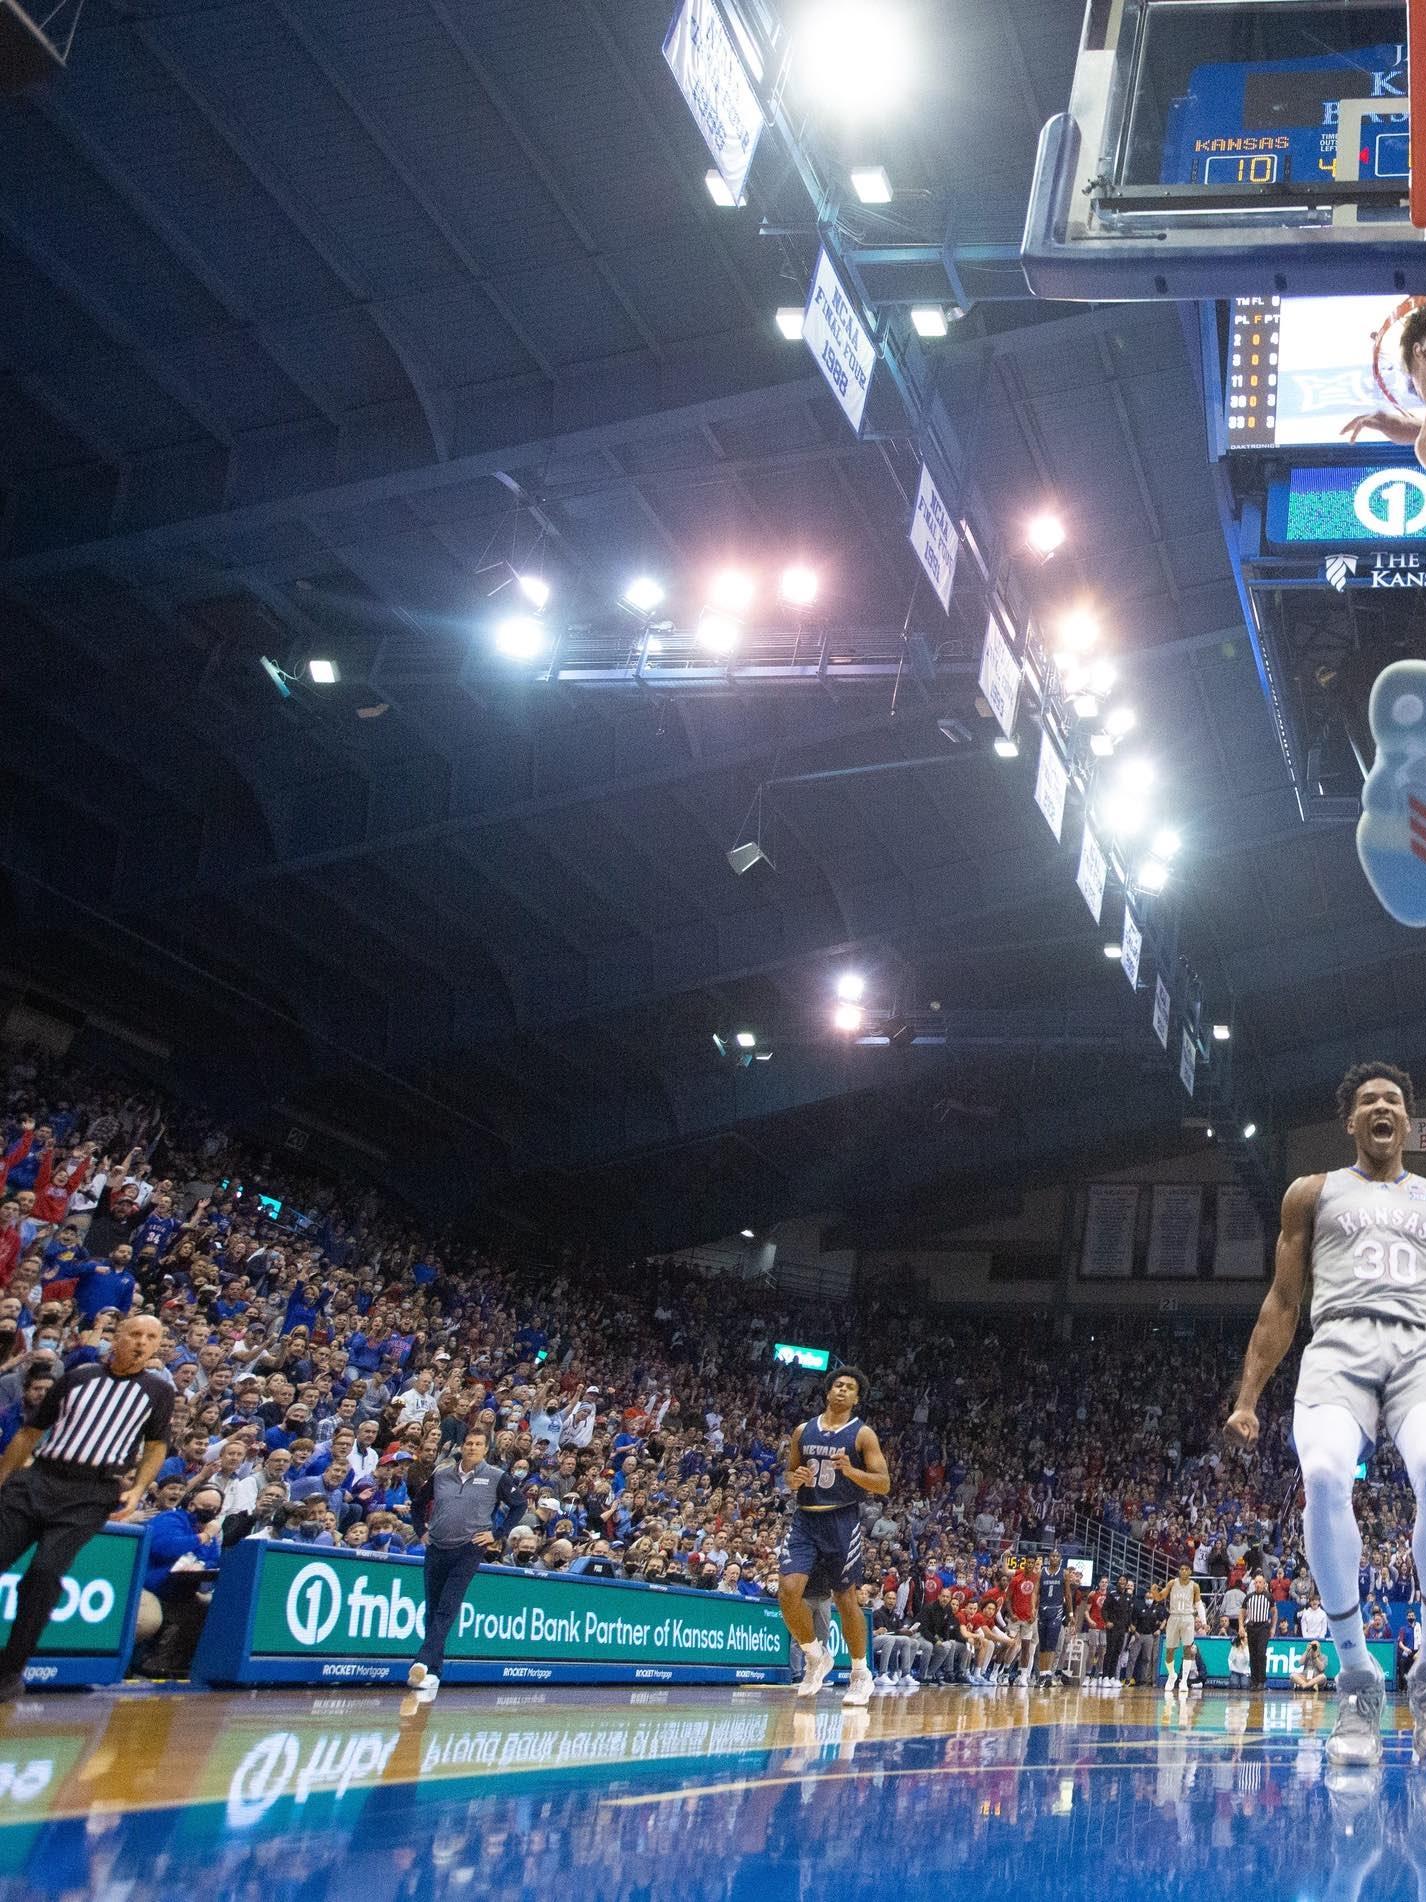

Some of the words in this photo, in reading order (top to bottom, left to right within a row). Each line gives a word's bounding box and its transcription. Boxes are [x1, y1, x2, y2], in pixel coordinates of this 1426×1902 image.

[1195, 136, 1290, 152] KANSAS
[1238, 156, 1272, 182] 10
[1236, 298, 1250, 306] TM
[1252, 297, 1264, 305] FL
[831, 286, 859, 352] NCAA
[1235, 315, 1249, 325] PL
[1254, 314, 1262, 324] F
[1264, 314, 1280, 323] PT
[822, 340, 849, 397] 1988
[1371, 551, 1419, 568] THE
[1353, 1240, 1417, 1284] 30
[802, 1444, 846, 1456] NEVADA
[458, 1602, 527, 1640] Proud
[530, 1607, 581, 1643] Bank
[584, 1611, 650, 1646] Partner
[654, 1618, 671, 1647] of
[673, 1619, 724, 1650] Kansas
[727, 1623, 781, 1653] Athletics
[322, 1664, 356, 1676] ROCKET
[356, 1666, 390, 1677] Mortgage
[503, 1667, 527, 1677] ROCKET
[527, 1667, 552, 1679] Mortgage
